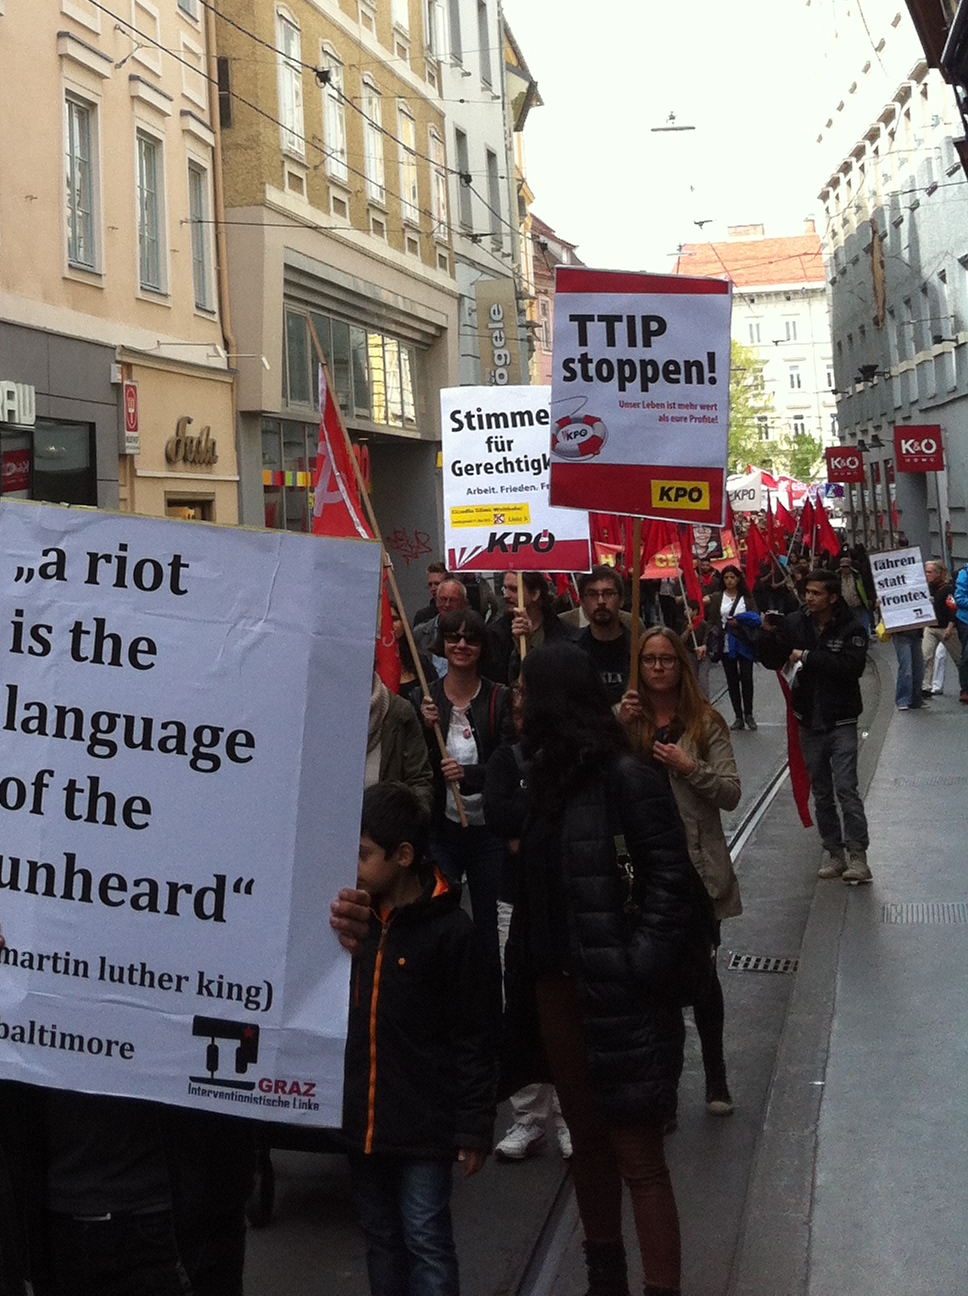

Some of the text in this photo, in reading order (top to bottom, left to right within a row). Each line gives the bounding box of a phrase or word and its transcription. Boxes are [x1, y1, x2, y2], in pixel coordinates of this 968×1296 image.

[569, 314, 667, 348] TTIP
[562, 352, 718, 393] stoppen!
[450, 407, 550, 433] Stimme
[618, 400, 641, 409] Unser
[642, 401, 666, 410] Leben
[667, 401, 676, 410] ist
[699, 403, 718, 411] wert
[485, 435, 514, 454] für
[466, 486, 498, 496] Arbeit.
[500, 484, 539, 494] Frieden.
[85, 543, 190, 596] riot
[877, 575, 907, 589] statt
[881, 591, 928, 606] frontex
[9, 609, 158, 671] is the
[3, 685, 256, 773] language
[64, 775, 153, 830] the
[99, 956, 190, 993] luther
[197, 976, 275, 1012] king)
[188, 1083, 320, 1112] Interventionistische Linke
[258, 1077, 317, 1098] GRAZ
